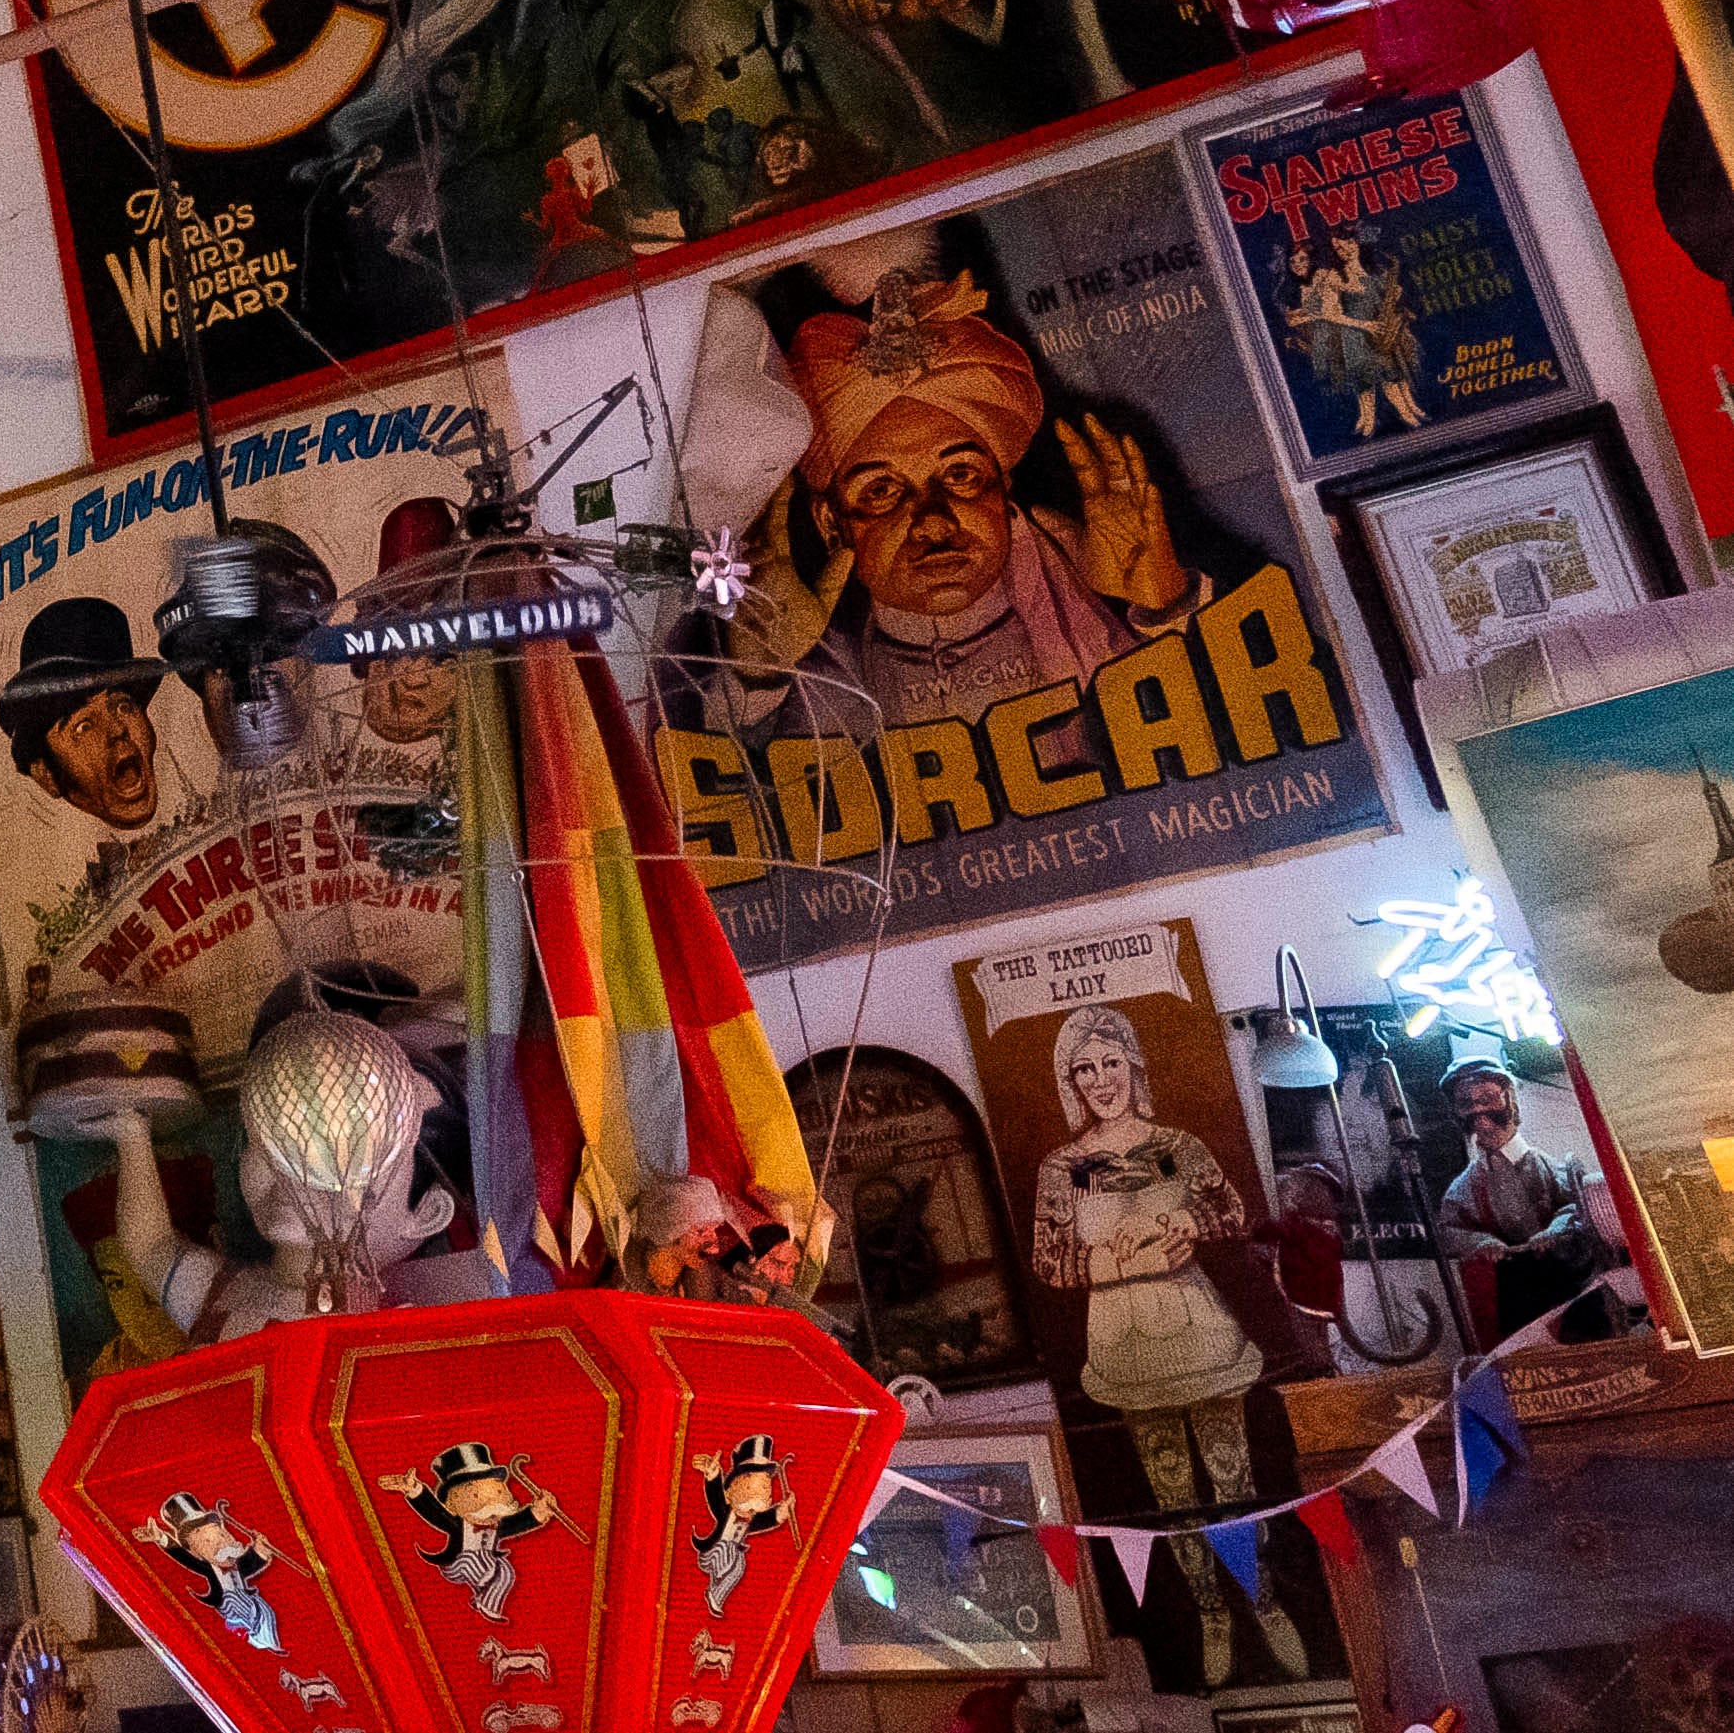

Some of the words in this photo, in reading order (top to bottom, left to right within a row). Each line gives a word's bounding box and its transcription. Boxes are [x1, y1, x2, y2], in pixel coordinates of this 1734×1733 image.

[1218, 107, 1472, 223] SIAMESE
[1272, 155, 1458, 242] TWINS
[1107, 306, 1131, 336] OF
[1140, 285, 1208, 326] INDIA
[1456, 334, 1514, 363] BORN
[1438, 353, 1516, 384] JOINED
[653, 563, 1342, 890] SORCAR
[801, 855, 942, 926] WORLD'S
[958, 815, 1129, 890] GREATEST
[1149, 766, 1336, 843] MAGICIAN
[81, 906, 156, 986] THE
[139, 814, 306, 931] THREE
[145, 905, 254, 993] AROUND
[409, 884, 443, 914] IN
[993, 956, 1037, 982] THE
[1047, 933, 1153, 973] TATTOOED
[1049, 973, 1106, 1002] LADY
